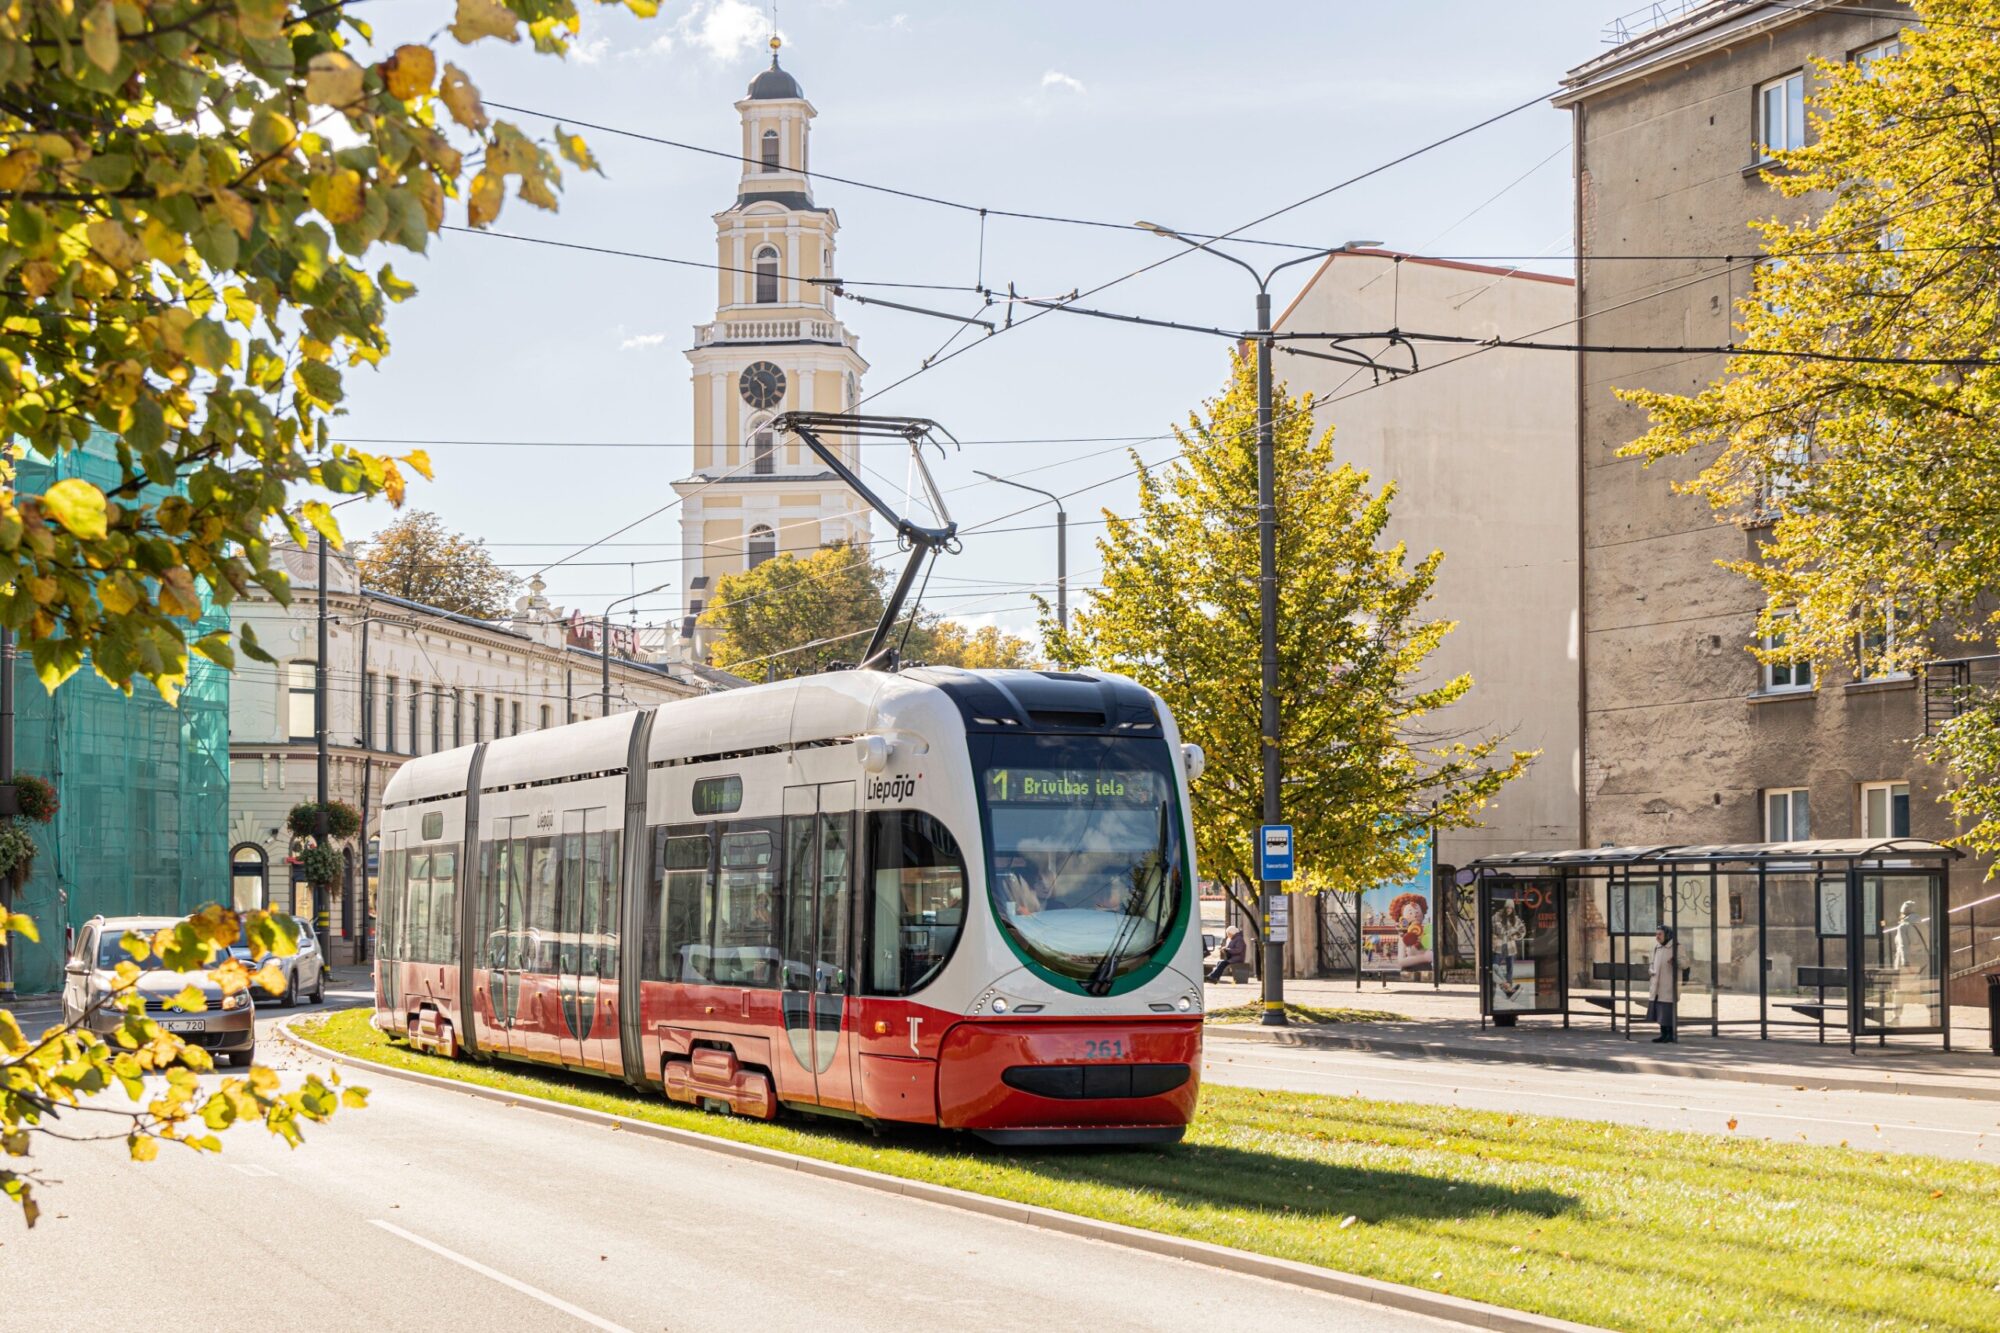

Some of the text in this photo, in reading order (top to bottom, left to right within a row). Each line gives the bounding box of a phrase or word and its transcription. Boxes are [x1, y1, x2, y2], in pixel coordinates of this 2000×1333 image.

[867, 774, 915, 804] Liepāja
[993, 769, 1124, 800] 1 Brīvības iela
[186, 1021, 203, 1030] 720
[1085, 1039, 1123, 1058] 261
